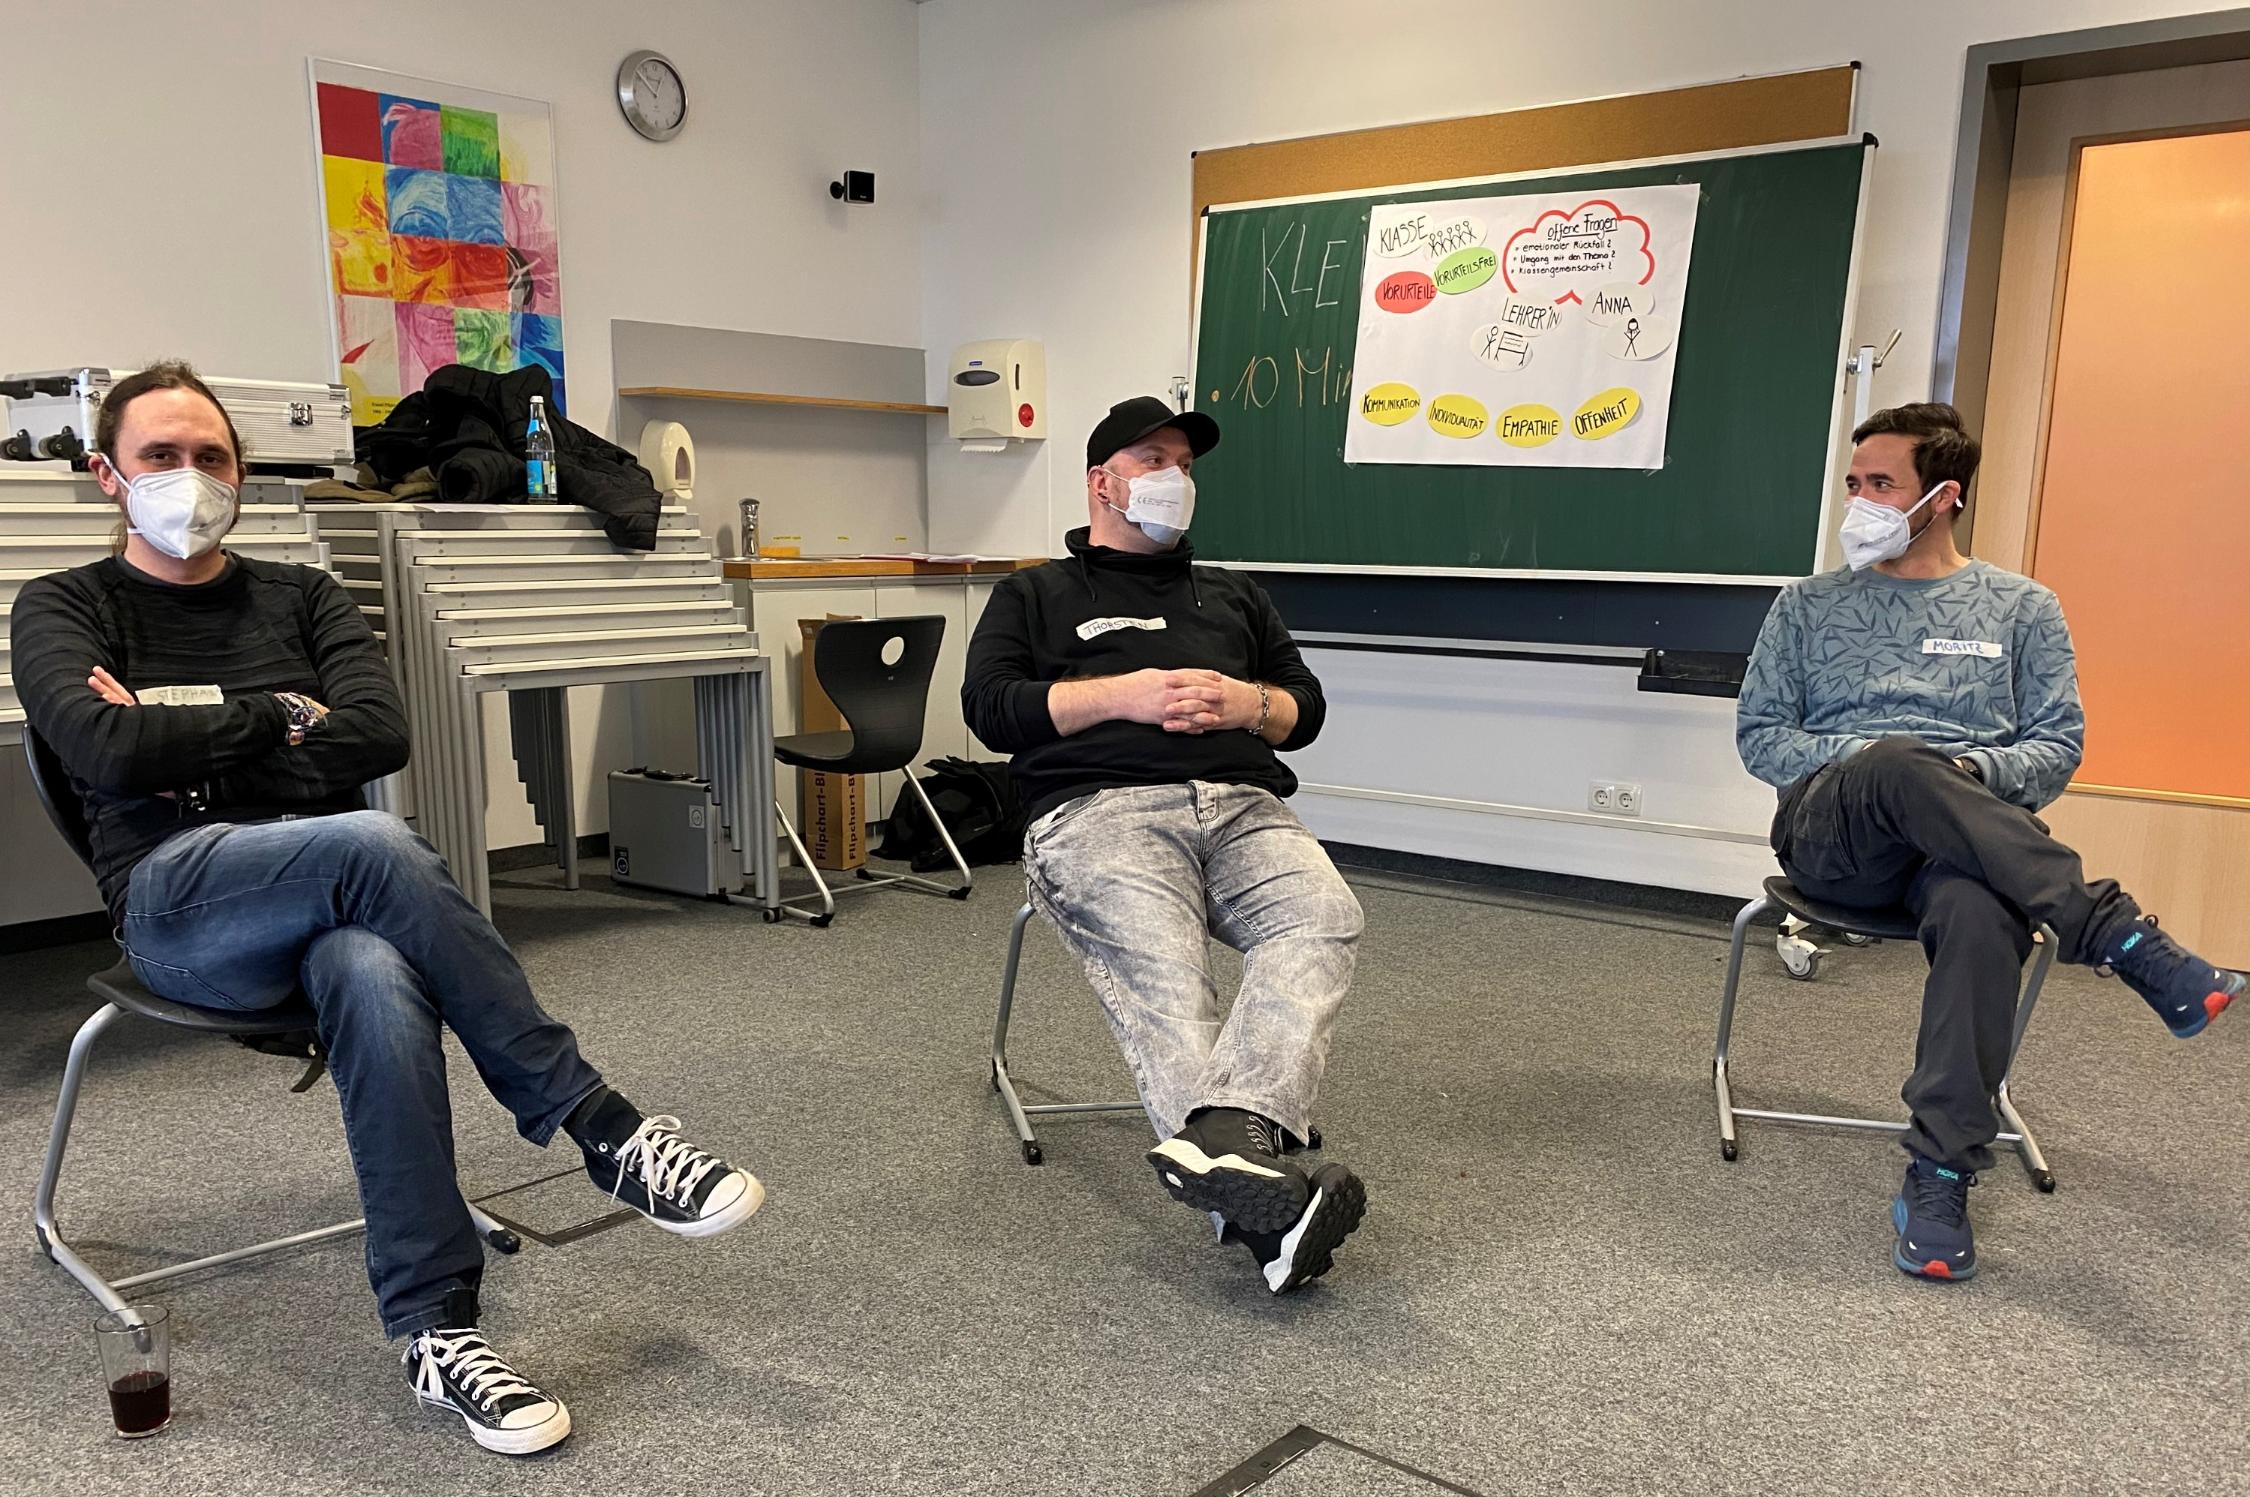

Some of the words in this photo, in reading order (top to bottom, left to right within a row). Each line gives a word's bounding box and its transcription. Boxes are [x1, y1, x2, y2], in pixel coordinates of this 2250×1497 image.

[1380, 215, 1428, 254] KLASSE
[1583, 213, 1618, 240] Fragen
[1520, 254, 1549, 267] Umgang
[1522, 242, 1570, 252] emotionaler
[1434, 255, 1497, 287] VORURTEILSFREI
[1383, 281, 1437, 301] VORURTEILE
[1592, 291, 1633, 315] ANNA
[1230, 355, 1279, 411] 10
[1503, 415, 1559, 438] EMPATHIE
[1574, 397, 1628, 435] OFFENHEIT
[814, 771, 829, 861] Flipchart-Bl
